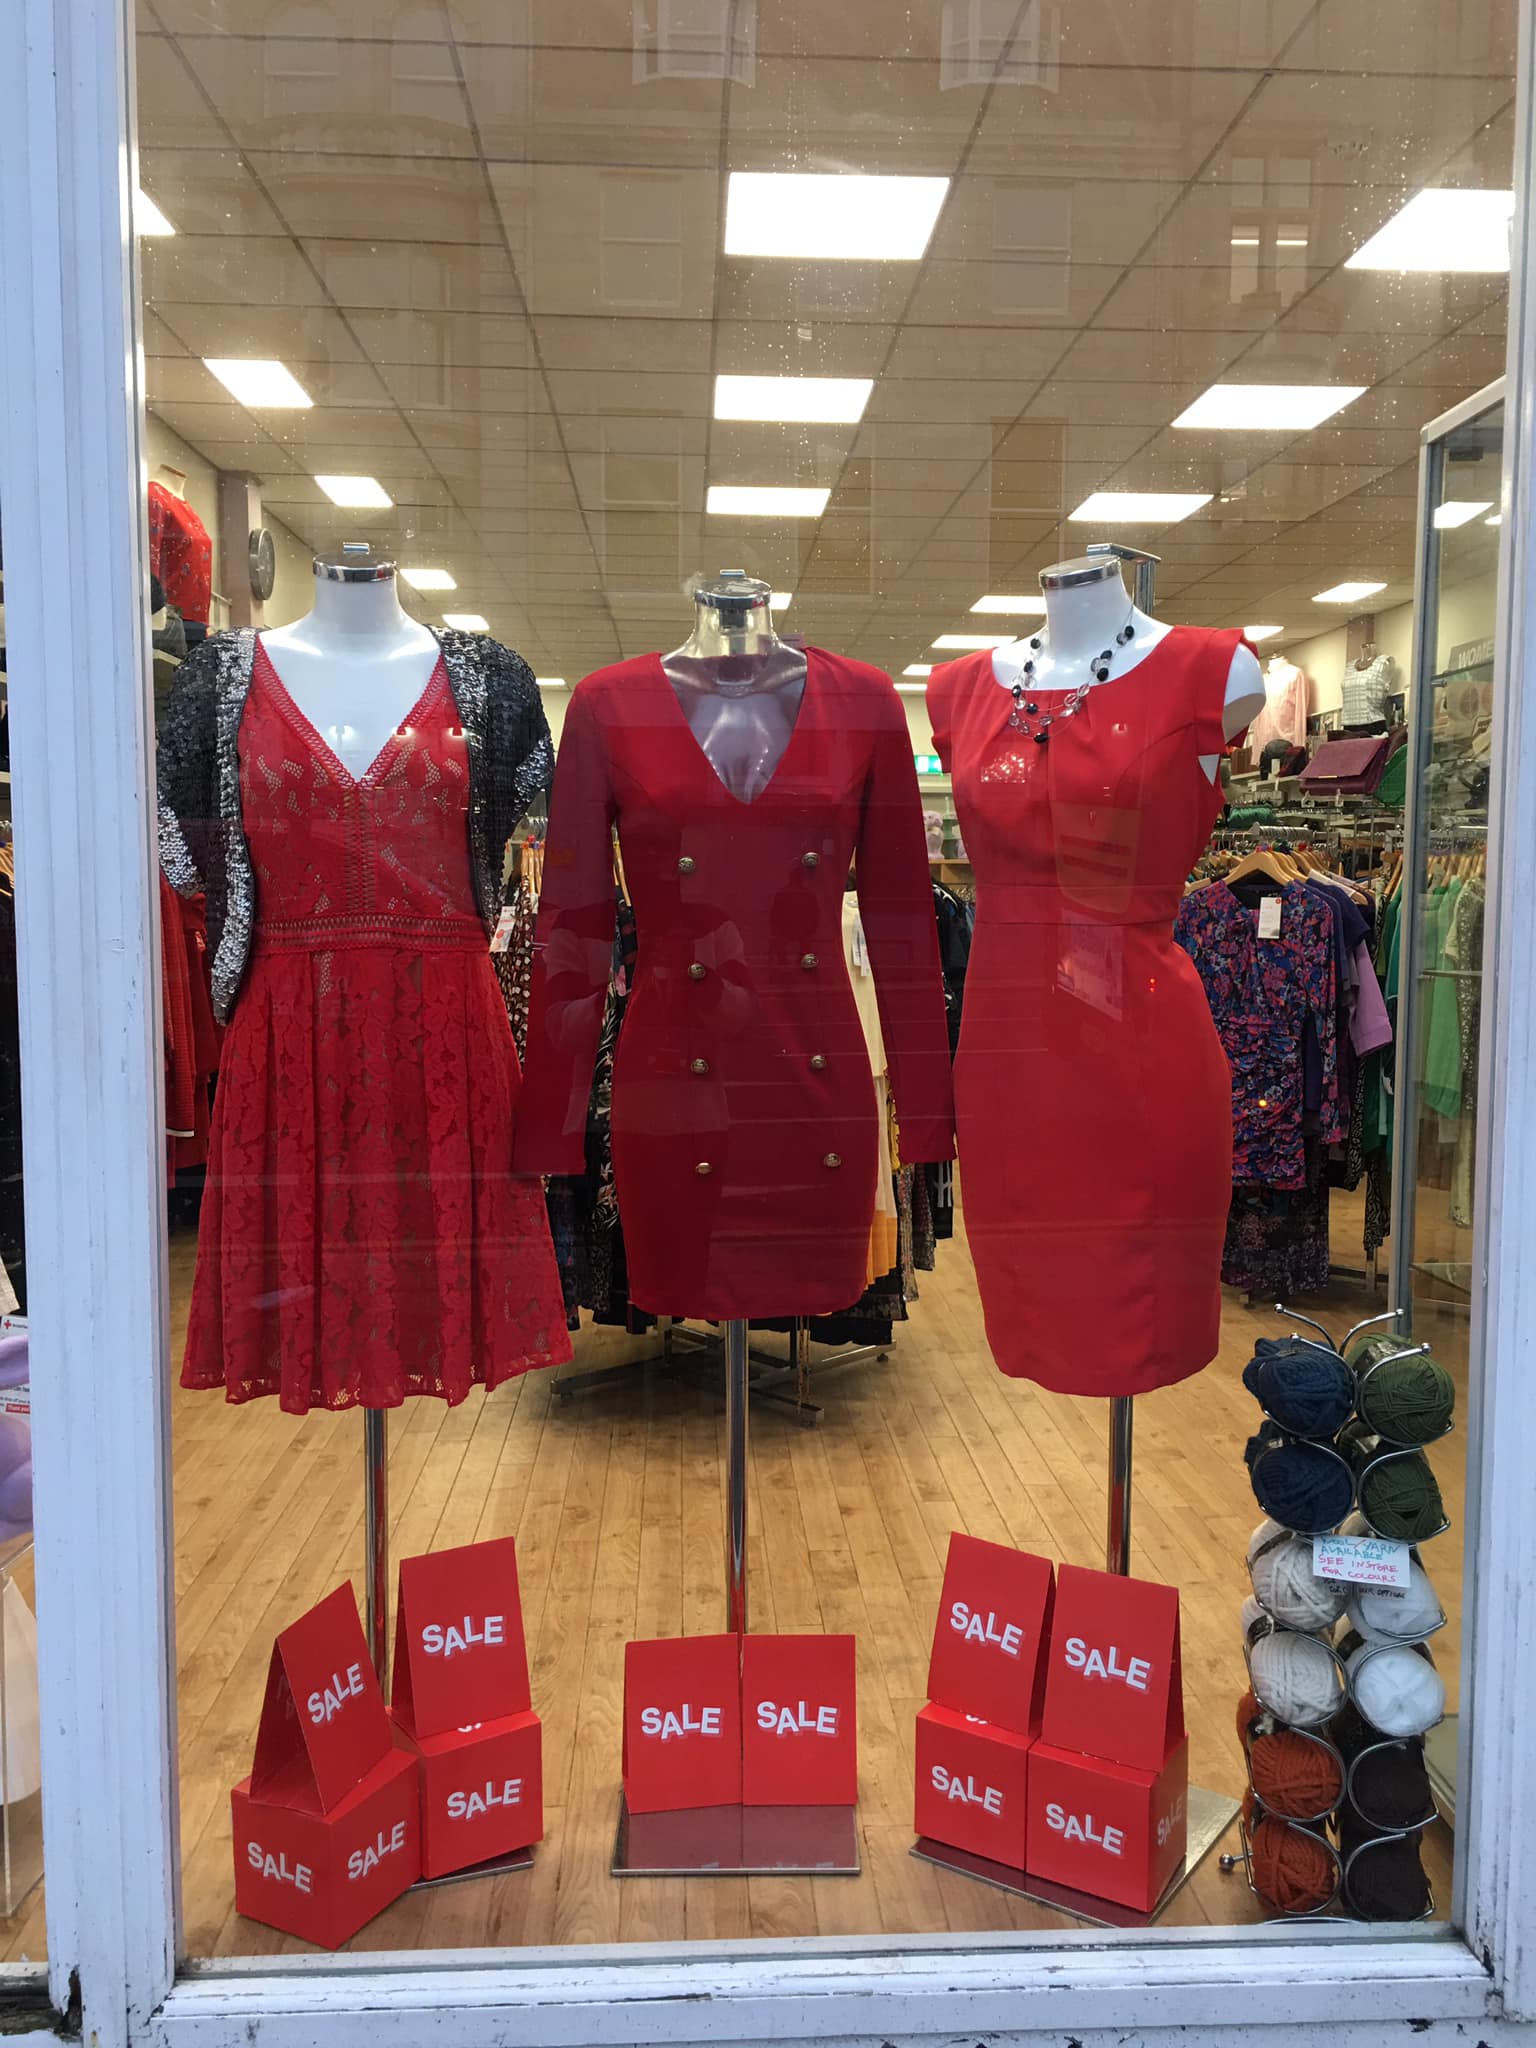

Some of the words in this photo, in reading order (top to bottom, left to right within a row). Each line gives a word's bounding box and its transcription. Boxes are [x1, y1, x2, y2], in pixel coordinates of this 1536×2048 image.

[1458, 640, 1495, 669] WOME
[1317, 1553, 1345, 1565] SEE
[1321, 1545, 1384, 1560] AVAILABLE
[1321, 1566, 1343, 1577] FOR
[1347, 1571, 1397, 1583] COLOURS
[422, 1615, 504, 1657] SALE
[950, 1601, 1023, 1656] SALE
[1064, 1637, 1151, 1690] SALE
[307, 1663, 364, 1723] SALE
[641, 1703, 721, 1740] SALE
[757, 1700, 838, 1735] SALE
[447, 1778, 522, 1820] SALE
[931, 1765, 1003, 1815] SALE
[348, 1821, 405, 1879] SALE
[1046, 1803, 1124, 1855] SALE
[247, 1842, 312, 1892] SALE
